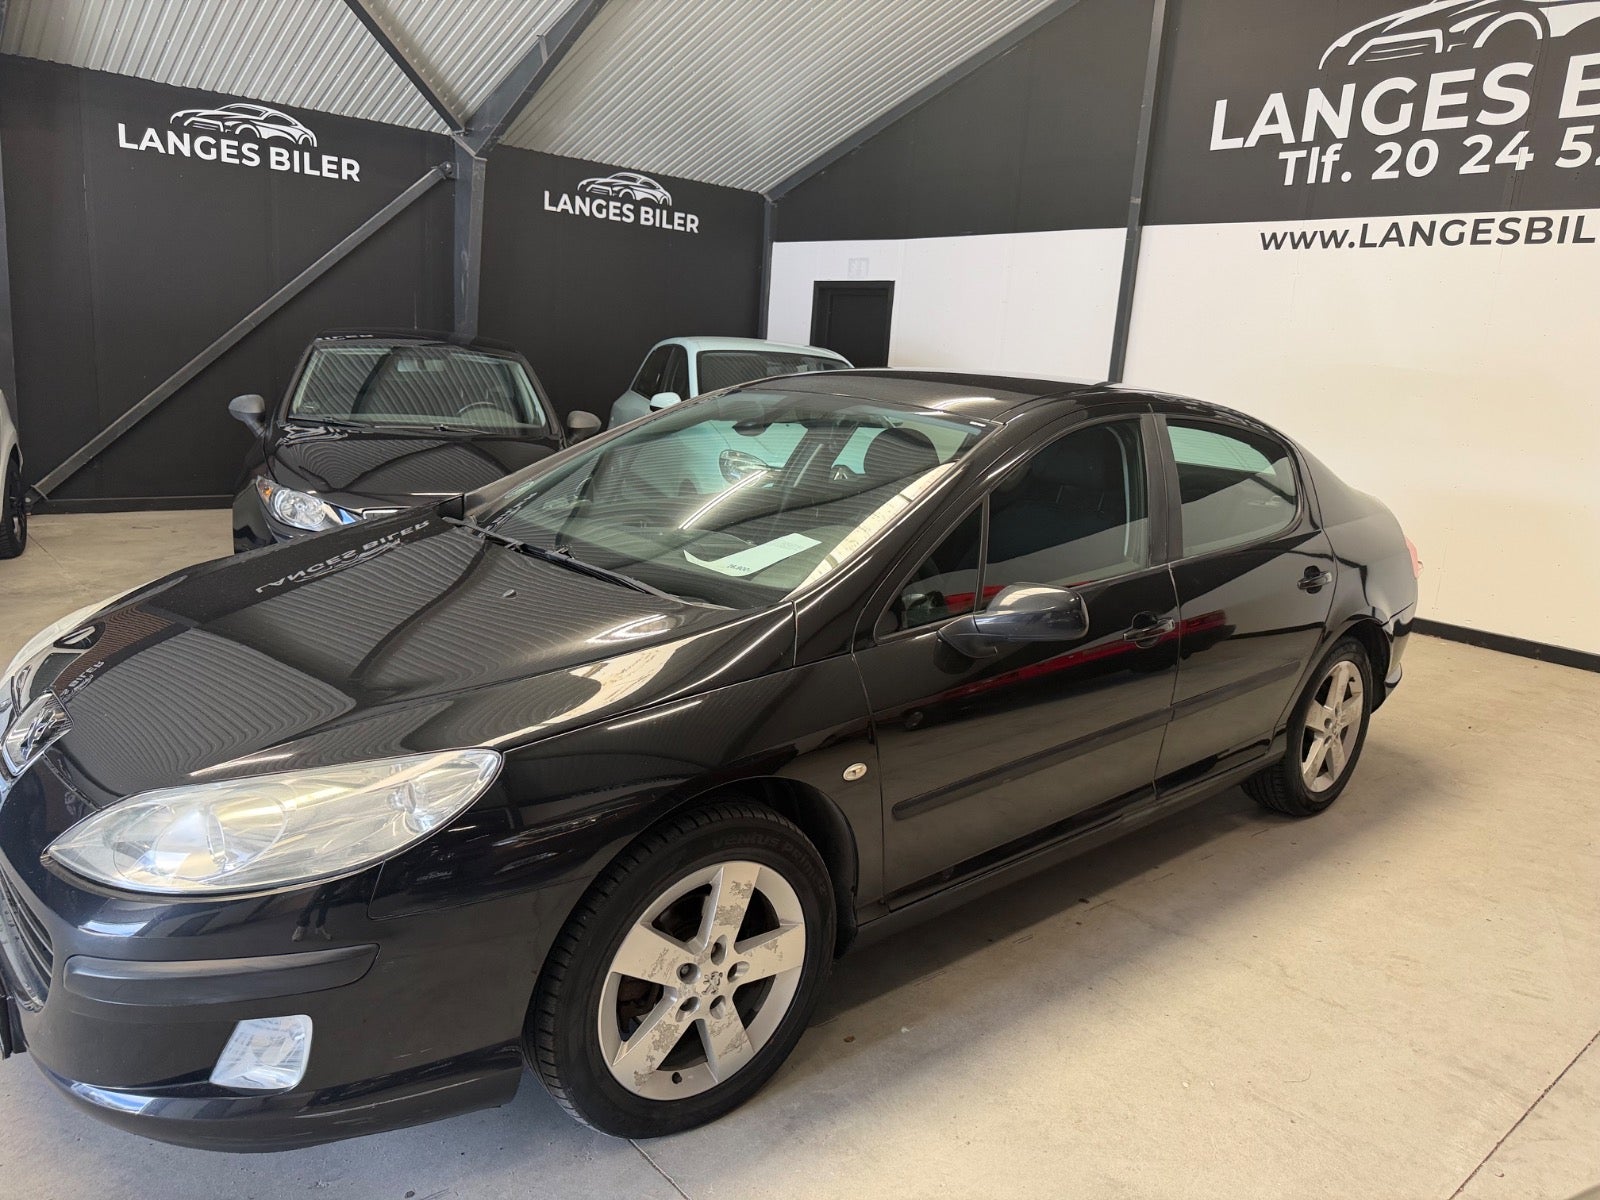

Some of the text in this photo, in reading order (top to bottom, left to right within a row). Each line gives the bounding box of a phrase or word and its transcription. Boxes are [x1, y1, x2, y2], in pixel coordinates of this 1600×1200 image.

[1210, 62, 1534, 151] LANGES
[117, 123, 361, 182] LANGES BILER
[1278, 125, 1600, 186] Tlf. 20 24 5
[543, 190, 700, 234] LANGES BILER
